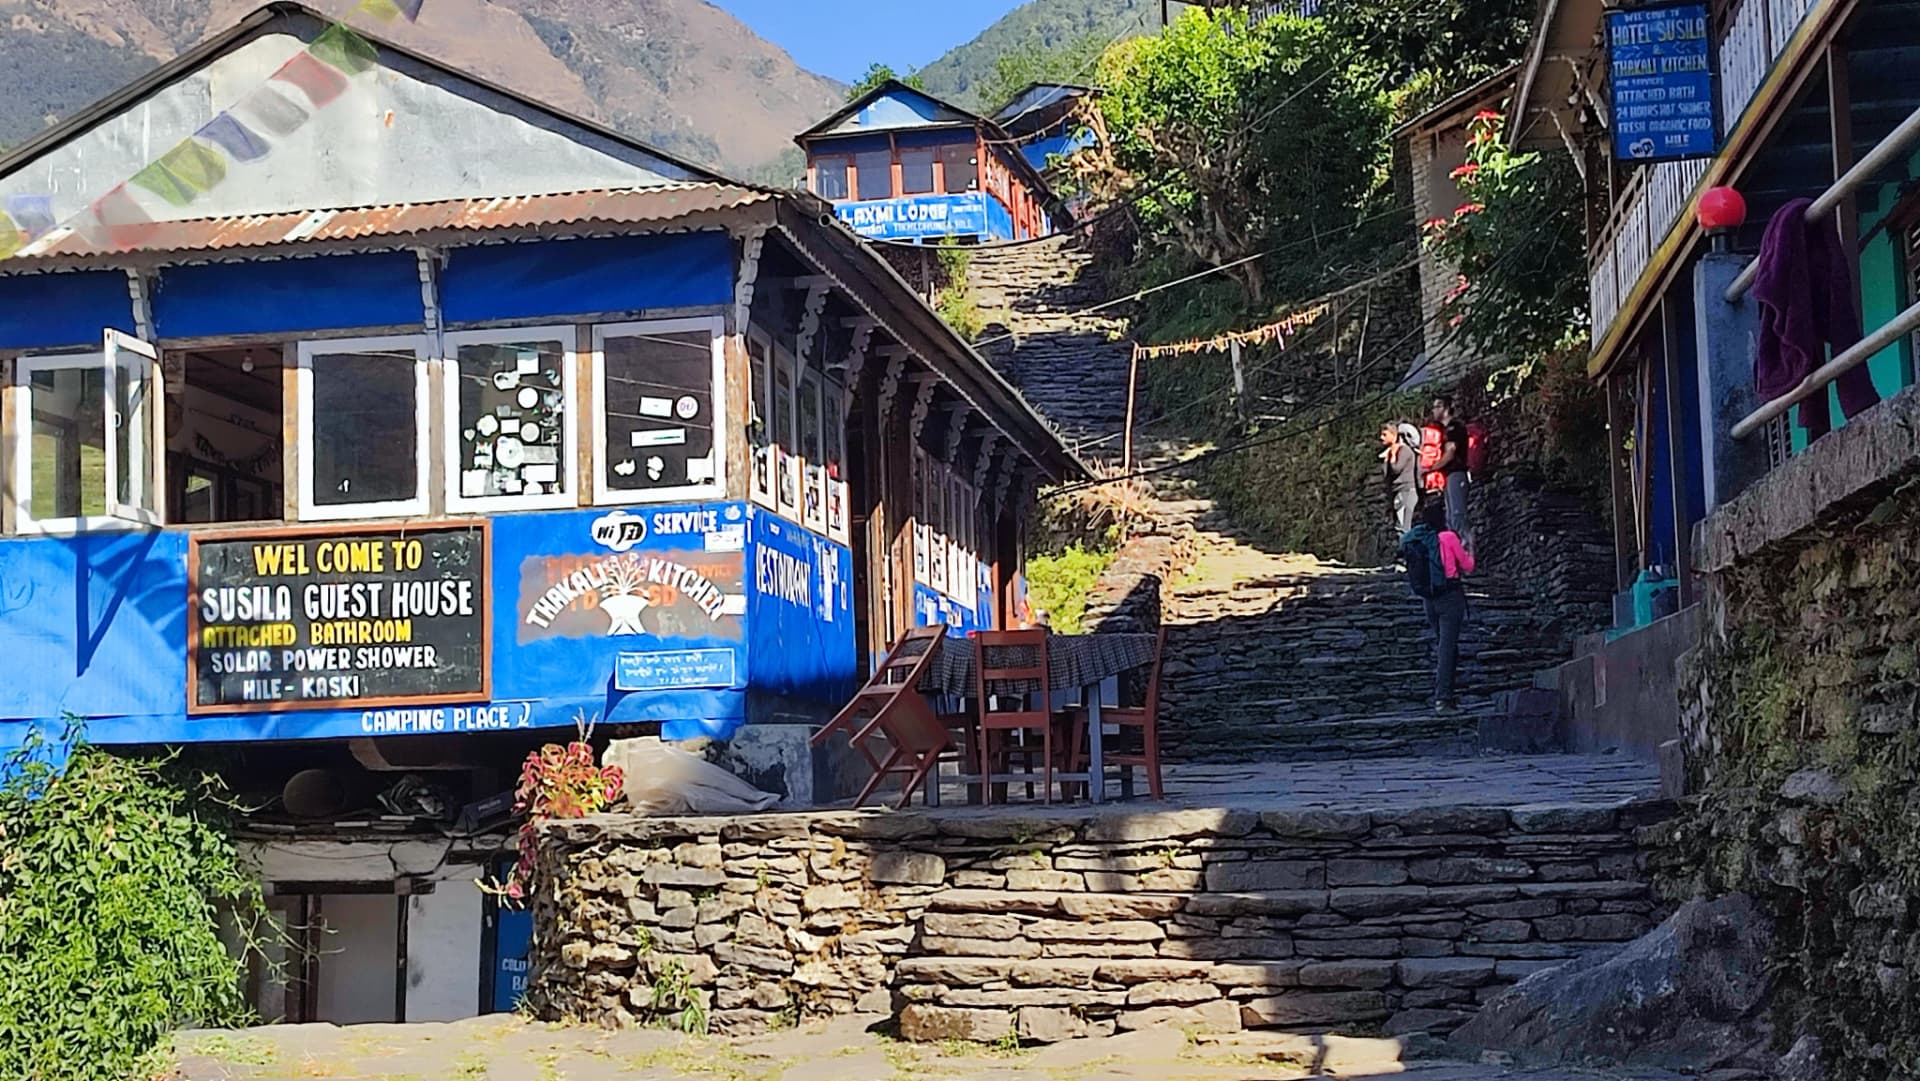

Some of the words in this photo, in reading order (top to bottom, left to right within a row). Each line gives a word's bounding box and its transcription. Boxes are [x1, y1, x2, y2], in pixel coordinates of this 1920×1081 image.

[1611, 23, 1651, 46] HOTEL
[1657, 17, 1706, 42] SUSILA
[1613, 57, 1656, 77] THAKALI
[1661, 54, 1706, 73] KITCHEN
[1616, 88, 1666, 103] ATTACHED
[1668, 85, 1695, 99] BATH
[1616, 106, 1629, 119] 24
[1630, 104, 1658, 118] HOURS
[1618, 121, 1646, 134] FRESH
[1688, 117, 1711, 130] FOOD
[841, 205, 894, 226] LAXMI
[896, 202, 948, 222] LODGE
[653, 510, 718, 534] SERVICE
[392, 540, 422, 571] TO
[202, 583, 292, 622] SUSILA
[304, 582, 383, 619] GUEST
[391, 580, 473, 618] HOUSE
[525, 561, 609, 629] THAKALI
[647, 558, 726, 622] KITCHEN
[203, 624, 297, 648] ATTACHED
[310, 619, 411, 645] BATHROOM
[211, 650, 272, 673] SOLAR
[283, 647, 351, 671] POWER
[354, 645, 438, 669] SHOWER
[302, 676, 360, 698] KASKI
[361, 708, 445, 732] CAMPING
[453, 705, 510, 731] PLACE
